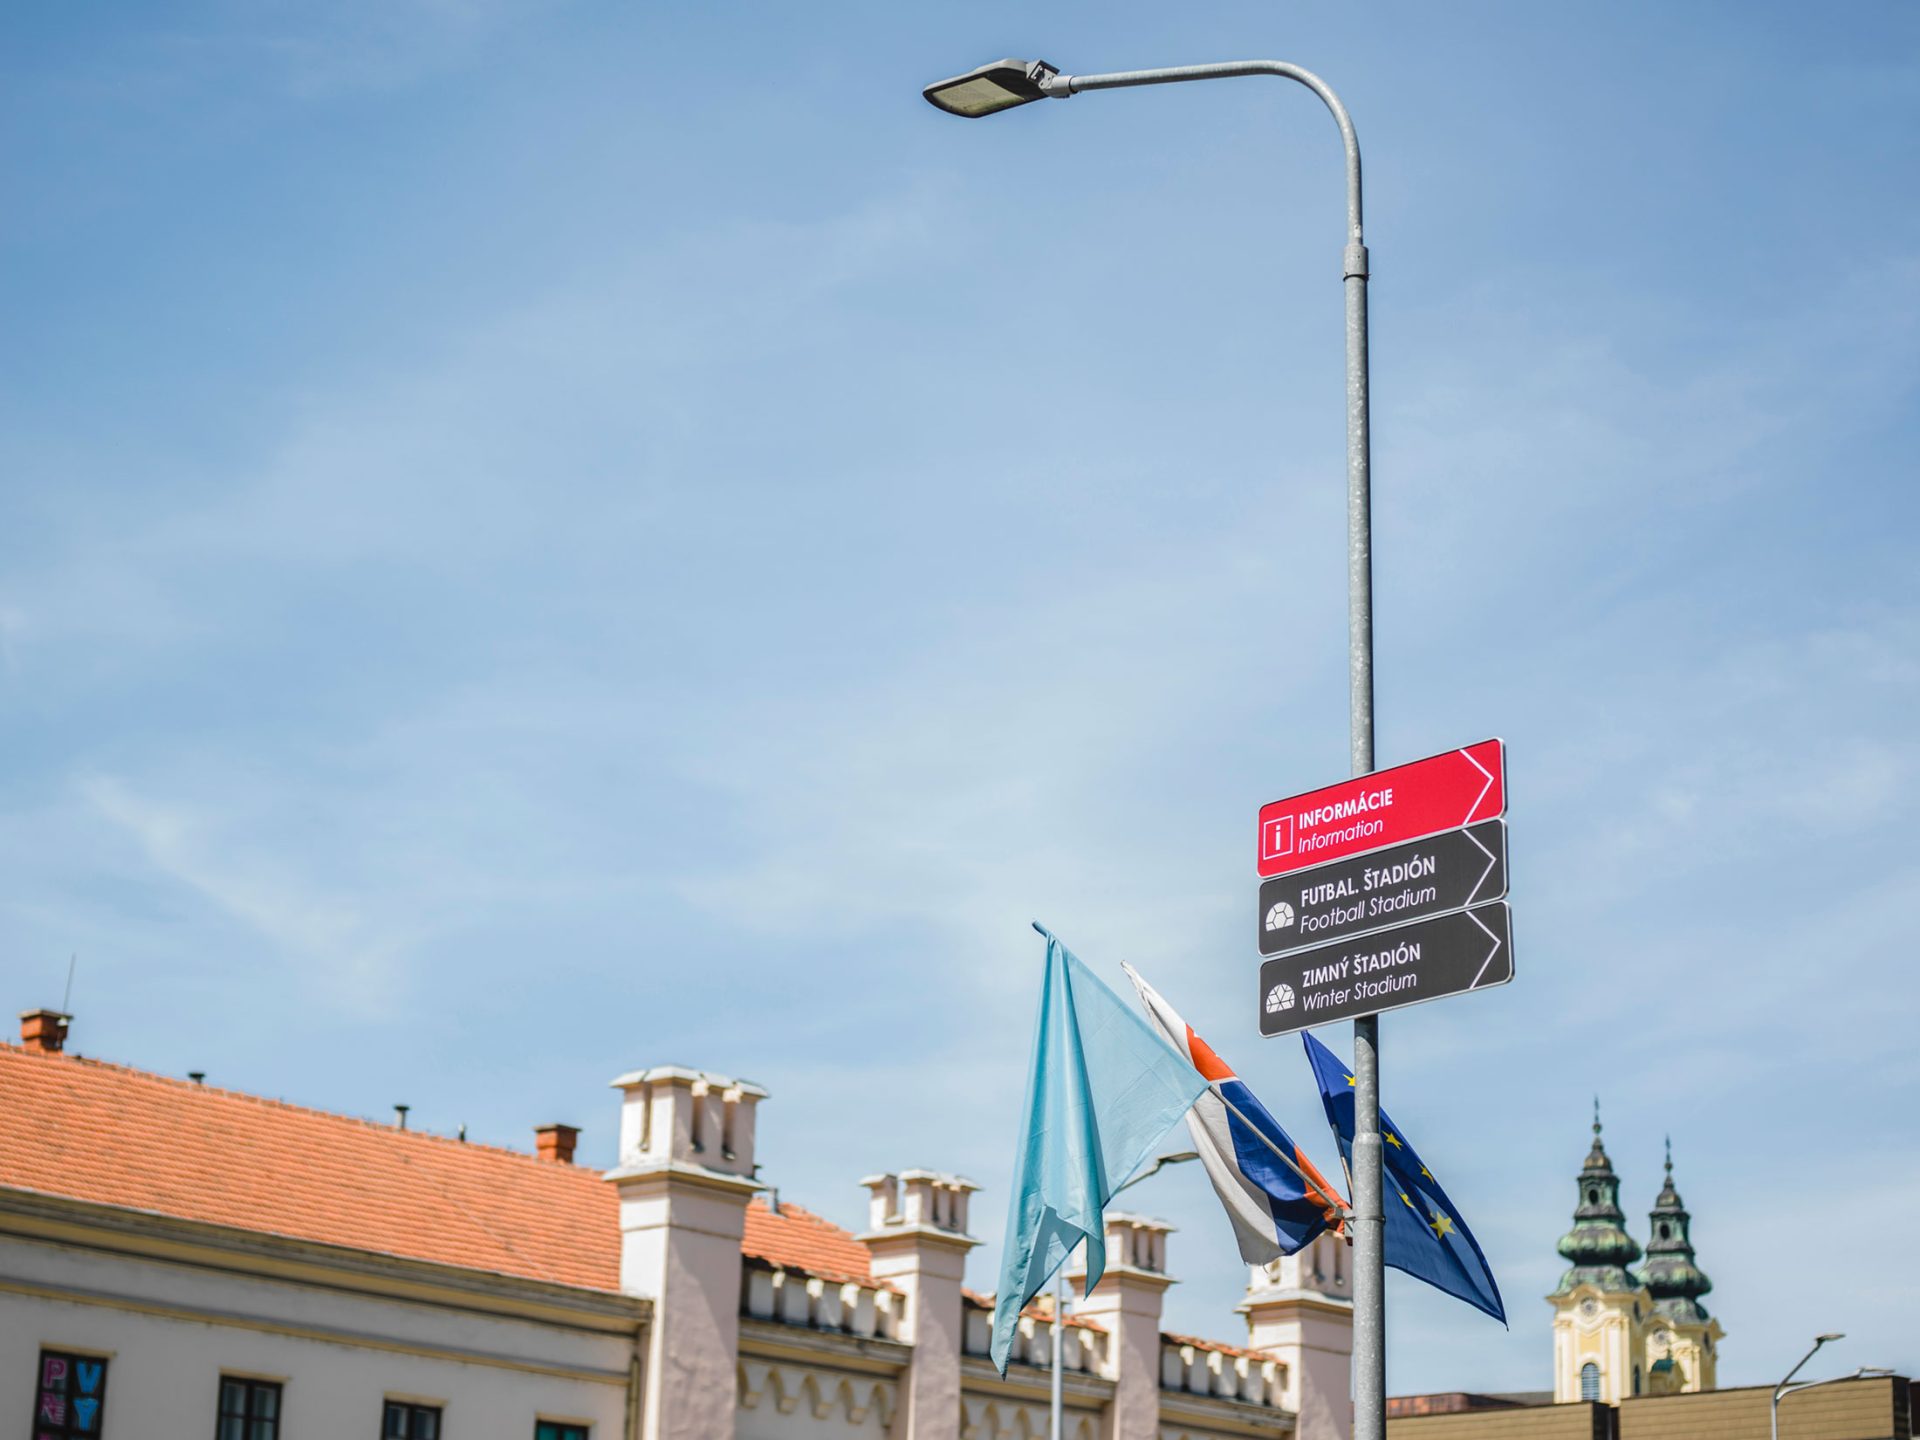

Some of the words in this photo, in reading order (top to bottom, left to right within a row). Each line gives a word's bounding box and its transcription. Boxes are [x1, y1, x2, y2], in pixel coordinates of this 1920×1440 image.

[1299, 788, 1393, 829] INFORMÁCIE
[1298, 819, 1384, 854] Information
[1301, 877, 1359, 908] FUTBAL.
[1363, 854, 1436, 892] ŠTADIÓN
[1300, 900, 1366, 934] Football
[1369, 886, 1437, 917] Stadium
[1302, 956, 1350, 988] ZIMNÝ
[1353, 941, 1421, 975] ŠTADIÓN
[1302, 988, 1351, 1012] Winter
[1353, 973, 1418, 1000] Stadium
